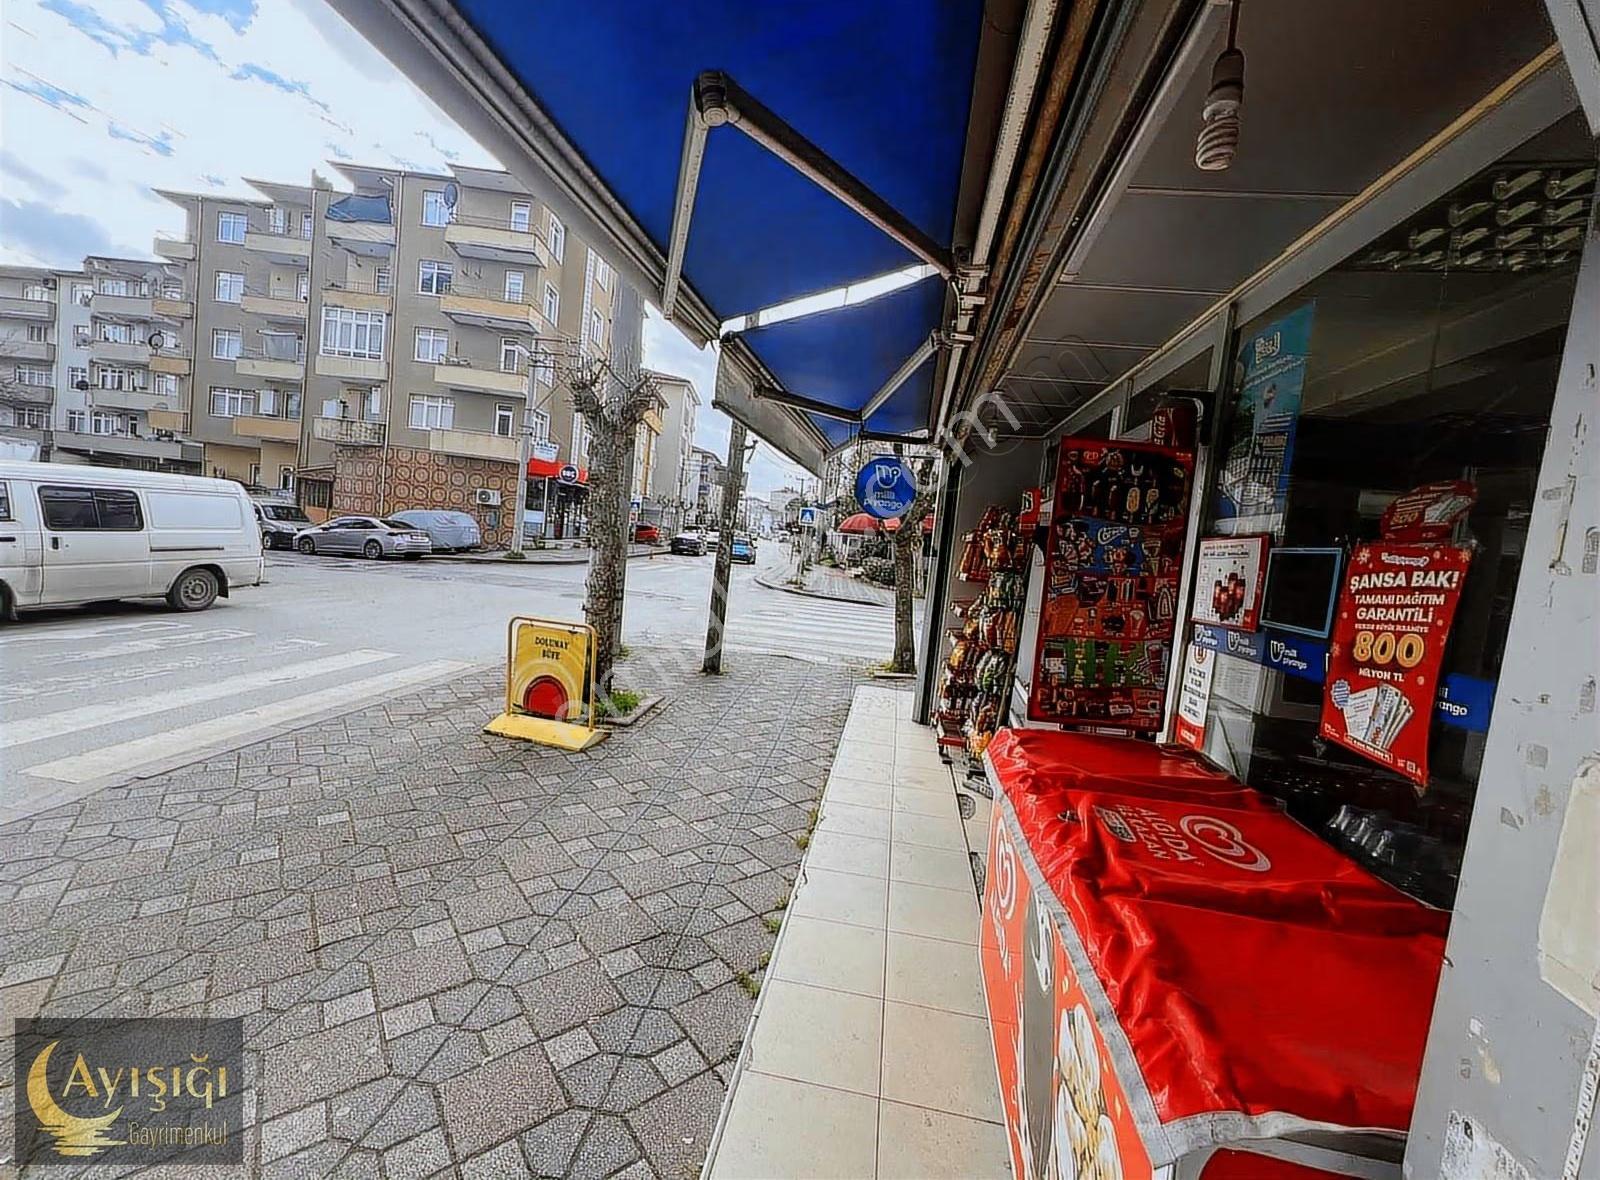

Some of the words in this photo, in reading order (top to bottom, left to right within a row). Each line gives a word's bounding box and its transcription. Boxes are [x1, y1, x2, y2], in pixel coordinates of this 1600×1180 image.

[1350, 571, 1407, 593] ŞANSA
[1411, 570, 1460, 590] BAK!
[1354, 594, 1395, 605] TAMAMI
[1356, 607, 1434, 623] GARANTİLİ
[1353, 631, 1425, 668] 800
[1393, 672, 1405, 682] TL
